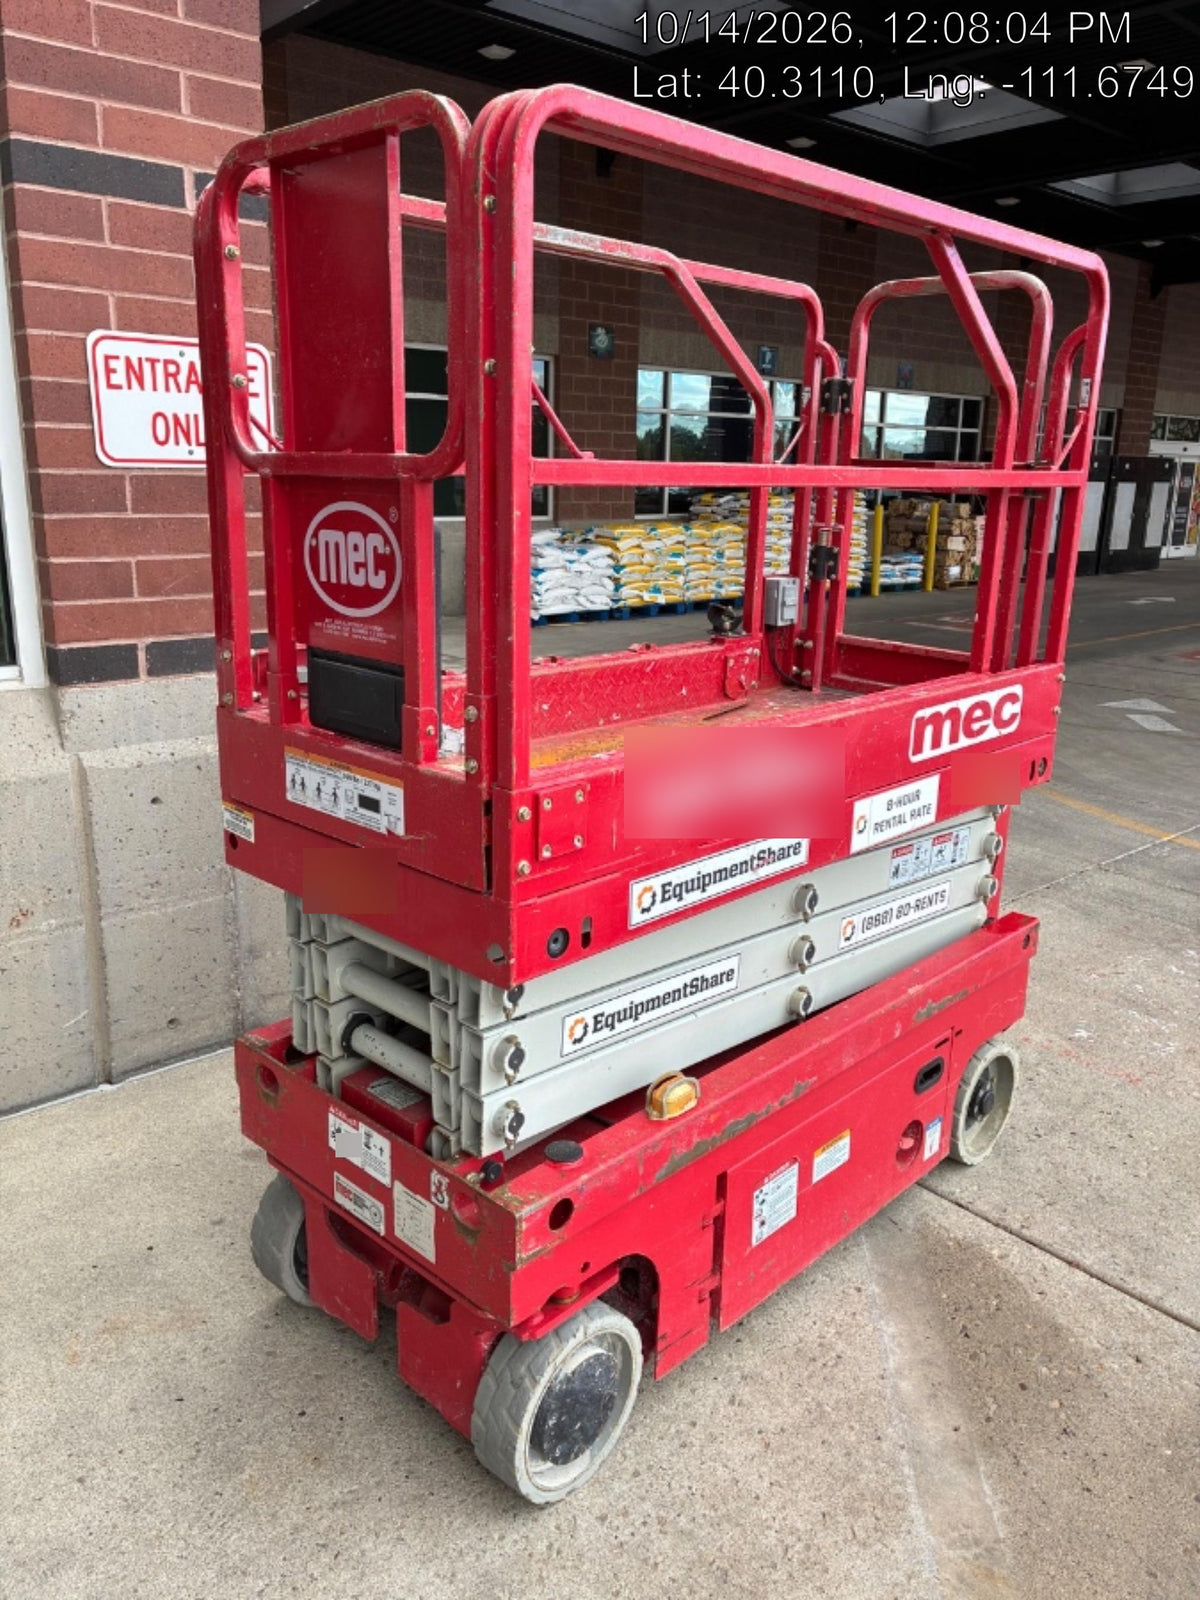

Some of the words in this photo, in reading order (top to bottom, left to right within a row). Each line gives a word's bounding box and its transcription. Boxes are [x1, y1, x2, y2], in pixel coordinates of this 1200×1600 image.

[103, 354, 260, 398] ENTRAE
[151, 411, 206, 446] ONL
[317, 529, 386, 589] mec
[911, 692, 1020, 757] mec
[872, 812, 908, 835] RENTAL
[909, 803, 932, 821] RATE
[886, 789, 921, 811] 8-HOUR
[659, 841, 802, 903] EquipmentShare
[861, 907, 894, 934] (888)
[592, 967, 735, 1033] EquipmentShare
